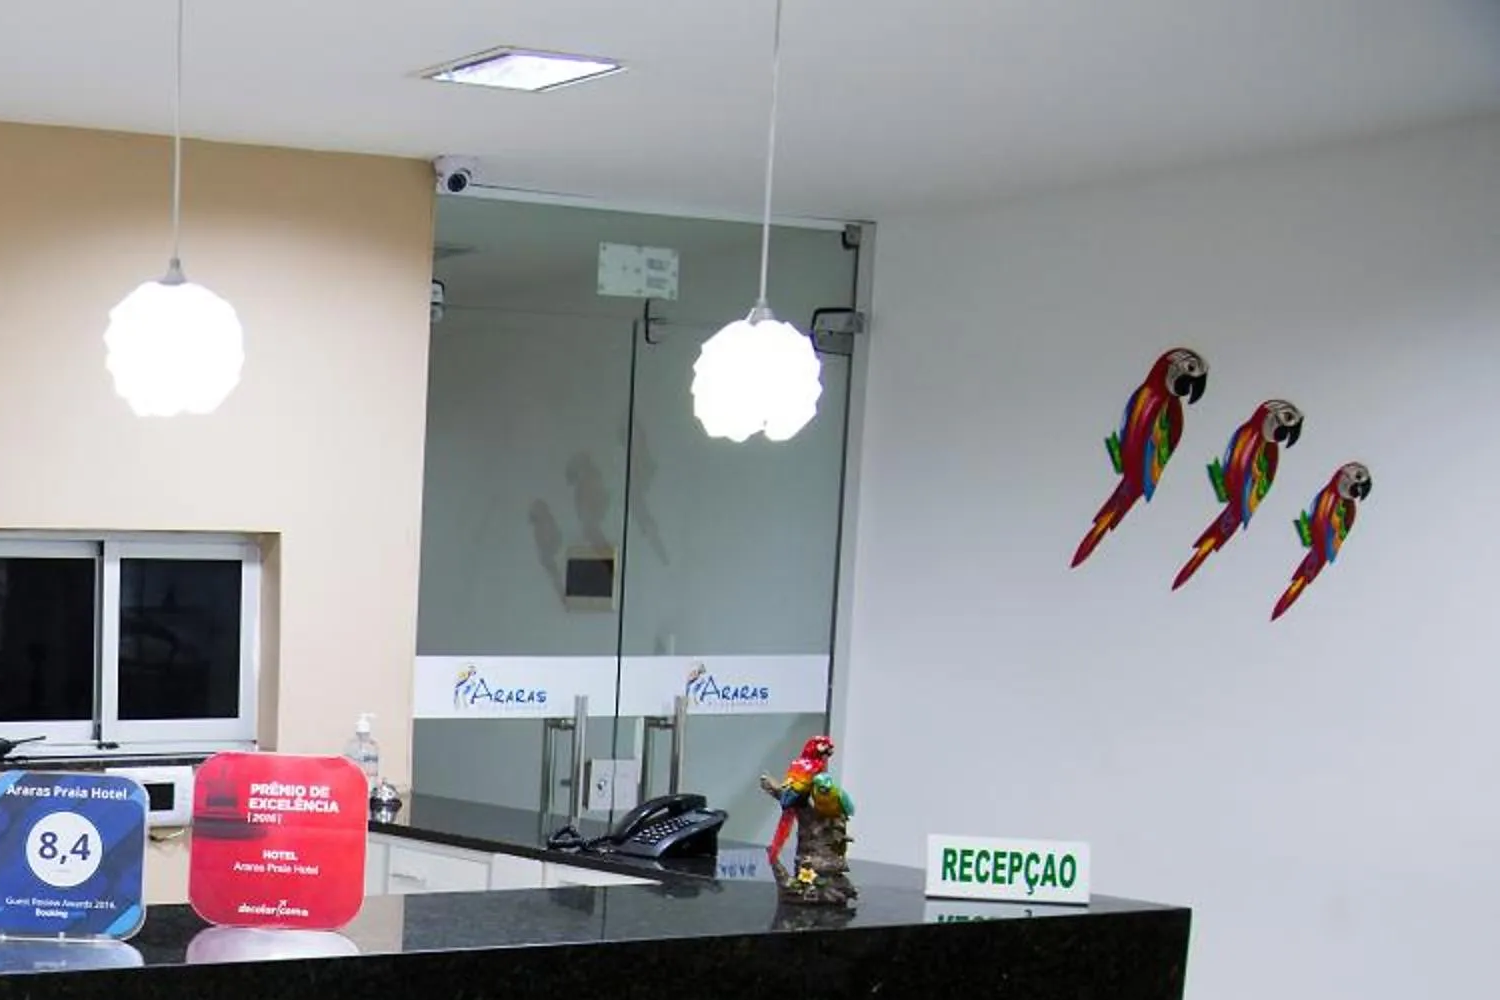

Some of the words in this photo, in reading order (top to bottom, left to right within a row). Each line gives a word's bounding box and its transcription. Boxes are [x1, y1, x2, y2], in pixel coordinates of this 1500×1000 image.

[6, 783, 50, 797] Araras
[53, 785, 88, 799] Praia
[91, 787, 127, 800] Hotel
[309, 785, 330, 798] DE
[38, 831, 91, 864] 8,4
[263, 850, 297, 861] HOTEL
